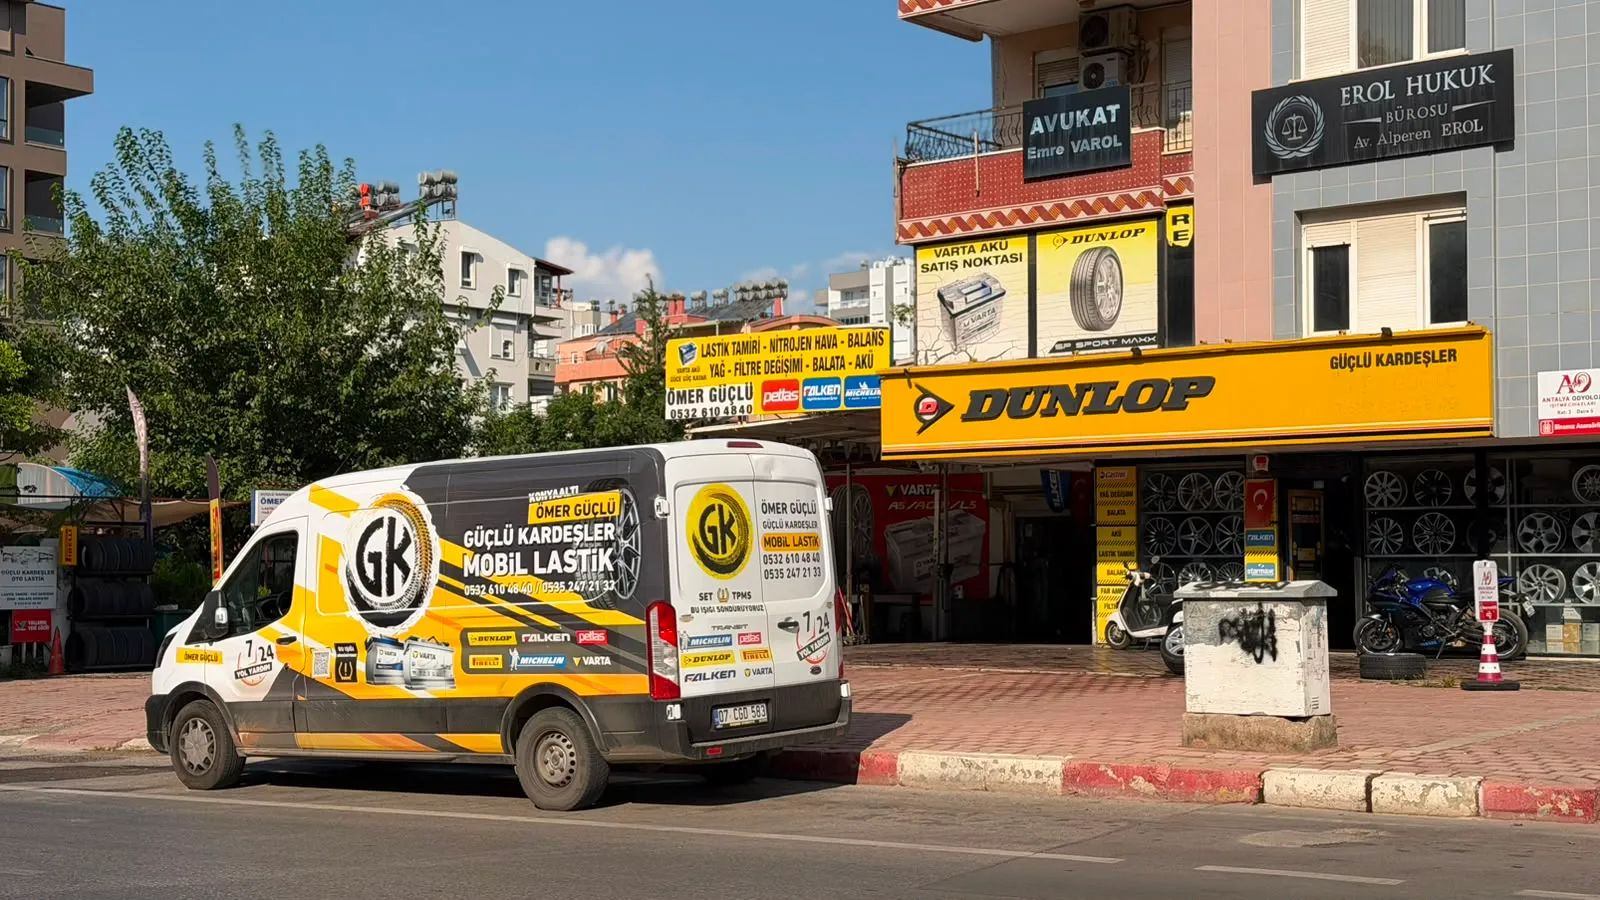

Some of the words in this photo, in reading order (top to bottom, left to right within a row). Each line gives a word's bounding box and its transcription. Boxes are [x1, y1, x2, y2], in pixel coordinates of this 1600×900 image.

[1341, 80, 1395, 106] EROL
[1406, 63, 1495, 96] HUKUK
[1030, 104, 1120, 135] AVUKAT
[1386, 103, 1448, 123] BÜROSU
[1354, 136, 1372, 149] Av.
[1377, 129, 1431, 146] Alperen
[1441, 119, 1483, 137] EROL
[1027, 146, 1065, 159] Emre
[1071, 134, 1122, 153] VAROL
[1070, 227, 1146, 245] DUNLOP
[934, 245, 976, 258] VARTA
[980, 237, 1009, 252] AKÜ
[921, 260, 959, 273] SATIŞ
[963, 252, 1023, 268] NOKTASI
[971, 307, 997, 325] VARTA
[701, 340, 730, 358] LASTİK
[732, 336, 760, 356] TAMİRİ
[769, 334, 812, 353] NİTROJEN
[814, 335, 838, 350] HAVA
[848, 331, 884, 348] BALANS
[1076, 339, 1118, 349] SPORT
[1122, 335, 1157, 345] MAXX
[710, 360, 725, 377] YAĞ
[734, 358, 761, 377] FİLTRE
[764, 355, 803, 377] DEĞİŞİMİ
[813, 355, 845, 372] BALATA
[854, 350, 873, 369] AKÜ
[1330, 352, 1371, 372] GÜÇLÜ
[1376, 348, 1457, 368] KARDEŞLER
[667, 386, 703, 405] ÖMER
[709, 382, 753, 406] GÜÇLÜ
[763, 388, 799, 404] petlas
[803, 384, 840, 397] FALKEN
[961, 376, 1215, 422] DUNLOP
[670, 407, 697, 419] 0532
[701, 405, 720, 418] 610
[723, 404, 753, 416] 4840
[528, 485, 579, 503] KONYAALTI
[536, 502, 570, 519] ÖMER
[574, 498, 616, 518] GÜÇLÜ
[761, 499, 788, 515] ÖMER
[790, 499, 817, 517] GÜÇLÜ
[699, 503, 737, 555] GK
[763, 520, 783, 531] GÜÇLÜ
[785, 520, 818, 530] KARDEŞLER
[463, 524, 514, 550] GÜÇLÜ
[518, 523, 616, 547] KARDEŞLER
[356, 515, 412, 598] GK
[763, 554, 783, 565] 0532
[785, 553, 799, 564] 610
[801, 553, 810, 563] 48
[812, 552, 820, 562] 40
[764, 569, 784, 580] 0535
[787, 568, 800, 579] 247
[802, 567, 811, 577] 21
[813, 567, 821, 577] 33
[464, 584, 486, 596] 0532
[489, 583, 505, 594] 610
[507, 582, 519, 594] 48
[520, 582, 533, 593] 40
[542, 581, 565, 593] 0535
[568, 580, 585, 592] 247
[589, 580, 600, 591] 21
[603, 579, 615, 591] 33
[699, 592, 713, 601] SET
[732, 591, 752, 600] TPMS
[690, 606, 699, 614] BU
[803, 611, 810, 633] 7
[816, 612, 829, 634] 24
[521, 632, 570, 643] FALKEN
[578, 631, 606, 643] petlas
[690, 636, 731, 646] MICHELIN
[246, 639, 253, 657] 7
[258, 644, 274, 662] 24
[743, 650, 769, 661] PIRELLI
[798, 646, 811, 658] YOL
[810, 635, 829, 651] YARDIM
[184, 651, 199, 660] ÖMER
[200, 652, 218, 663] GÜÇLÜ
[519, 656, 564, 665] MICHELIN
[582, 656, 611, 666] VARTA
[693, 654, 731, 663] DUNLOP
[236, 668, 248, 678] YOL
[248, 663, 271, 676] YARDIM
[684, 670, 736, 682] FALKEN
[752, 667, 773, 675] VARTA
[718, 709, 729, 723] 07
[733, 707, 748, 721] CGD
[751, 704, 766, 719] 583
